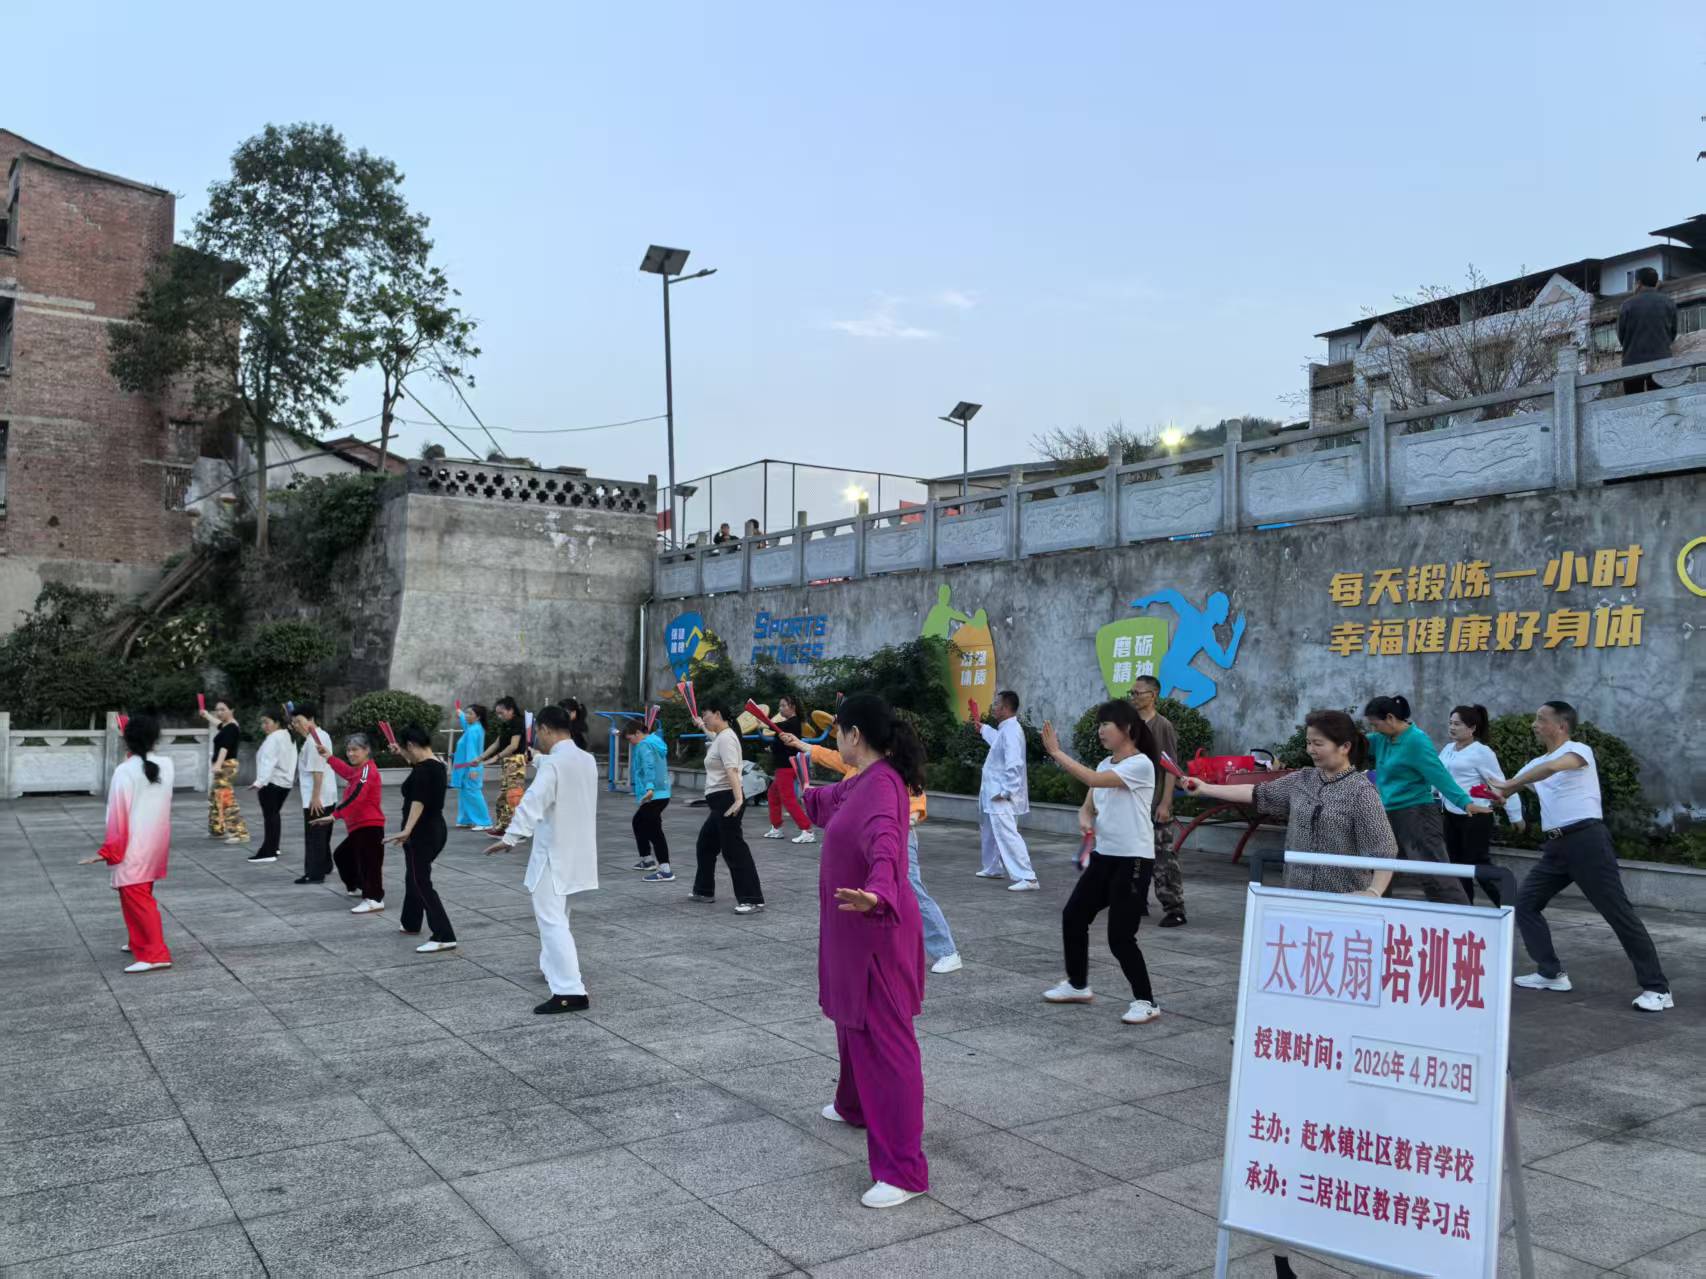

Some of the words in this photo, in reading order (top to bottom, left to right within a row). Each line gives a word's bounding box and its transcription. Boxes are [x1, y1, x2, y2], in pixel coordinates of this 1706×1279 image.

[1328, 544, 1644, 607] 每天锻炼一小时
[753, 611, 829, 639] SPORTS
[1113, 634, 1154, 658] 磨砺
[1328, 604, 1645, 656] 幸福健康好身体
[1112, 660, 1154, 683] 精神
[1263, 923, 1487, 1011] 太极扇培训班
[1254, 1025, 1343, 1071] 授课时间：
[1248, 1109, 1475, 1184] 主办：赶水镇社区教育学校
[1245, 1160, 1471, 1240] 承办：三居社区教育学习点
